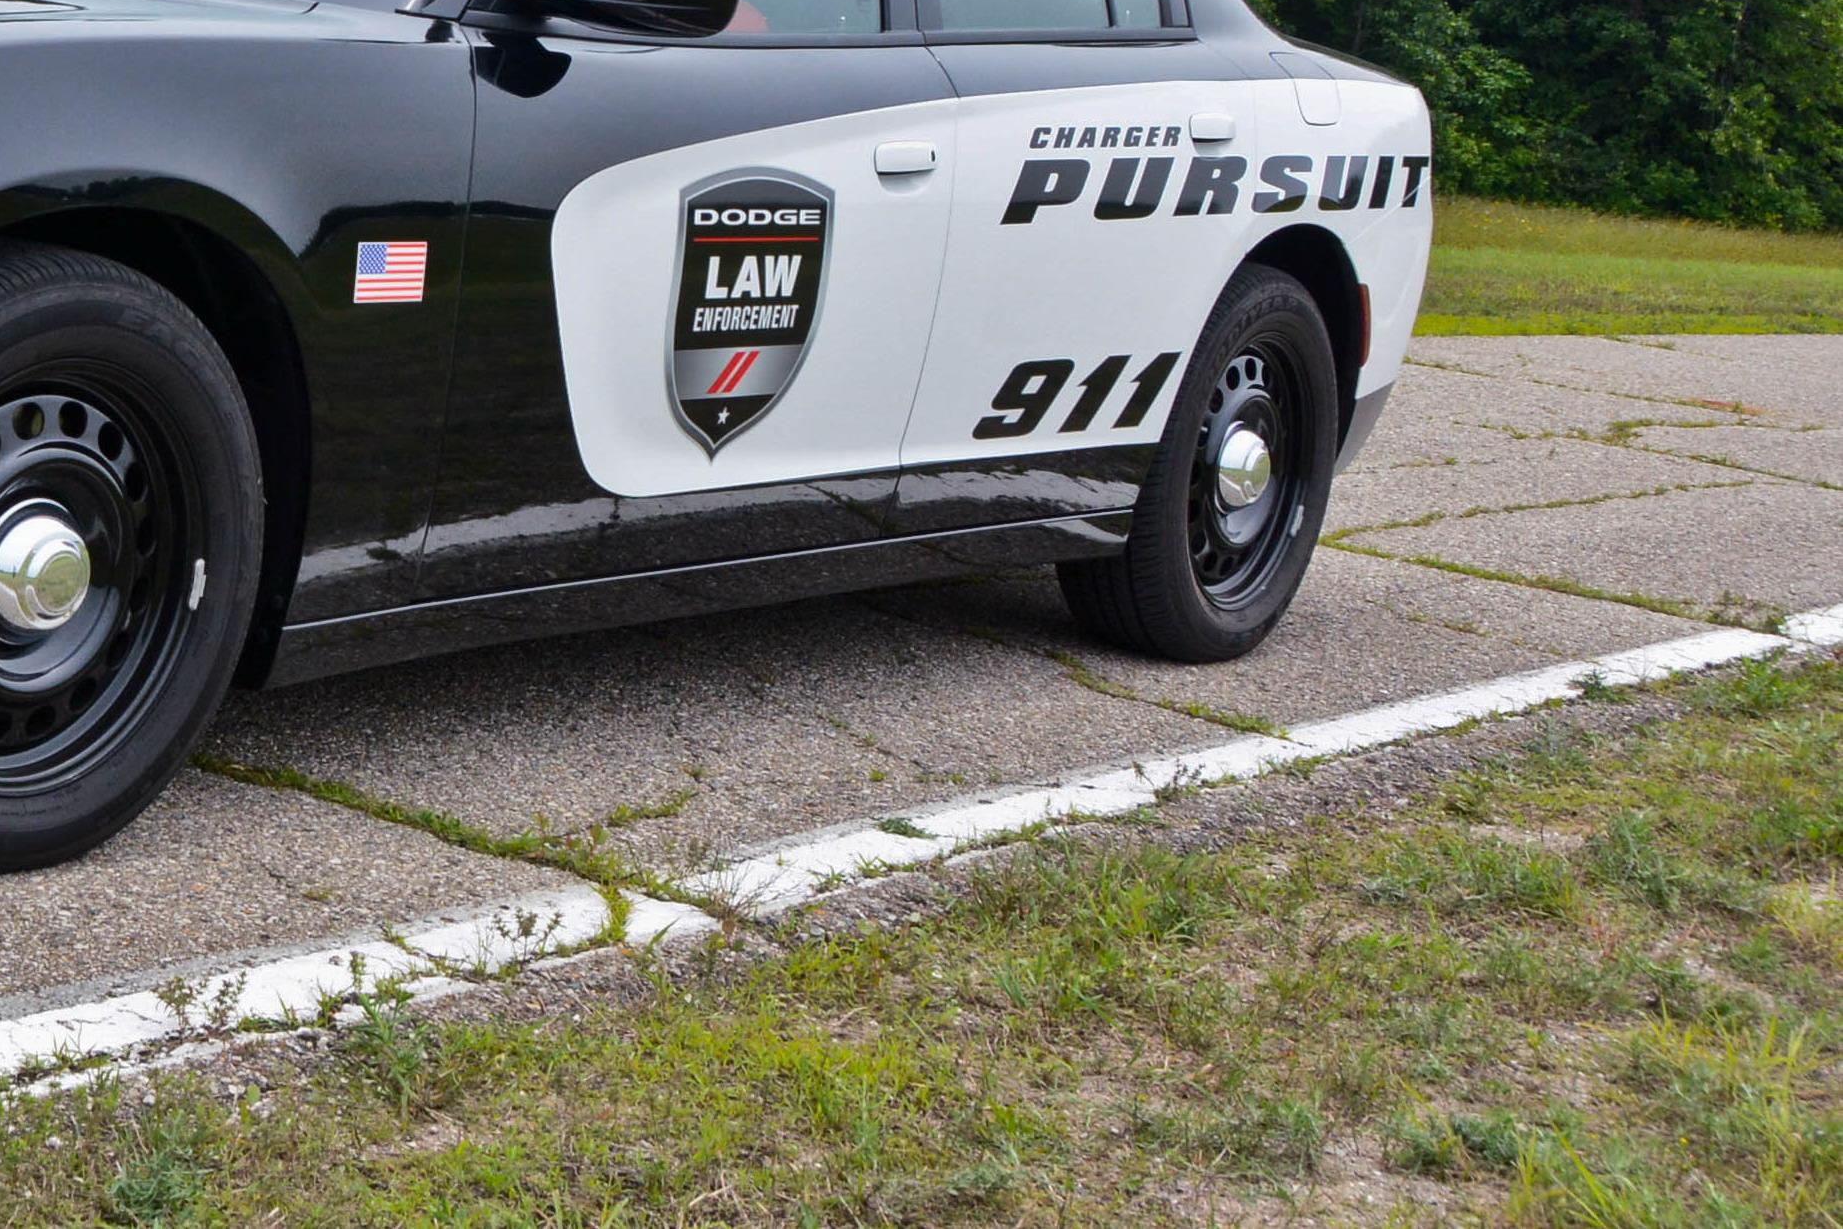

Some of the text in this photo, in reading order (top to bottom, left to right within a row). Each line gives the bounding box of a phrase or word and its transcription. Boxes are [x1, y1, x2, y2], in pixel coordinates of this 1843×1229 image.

[1029, 125, 1182, 149] CHARGER
[1000, 155, 1430, 226] PURSUIT
[694, 208, 821, 226] DODGE
[704, 255, 802, 300] LAW
[692, 304, 799, 333] ENFORCEMENT
[972, 351, 1182, 440] 911
